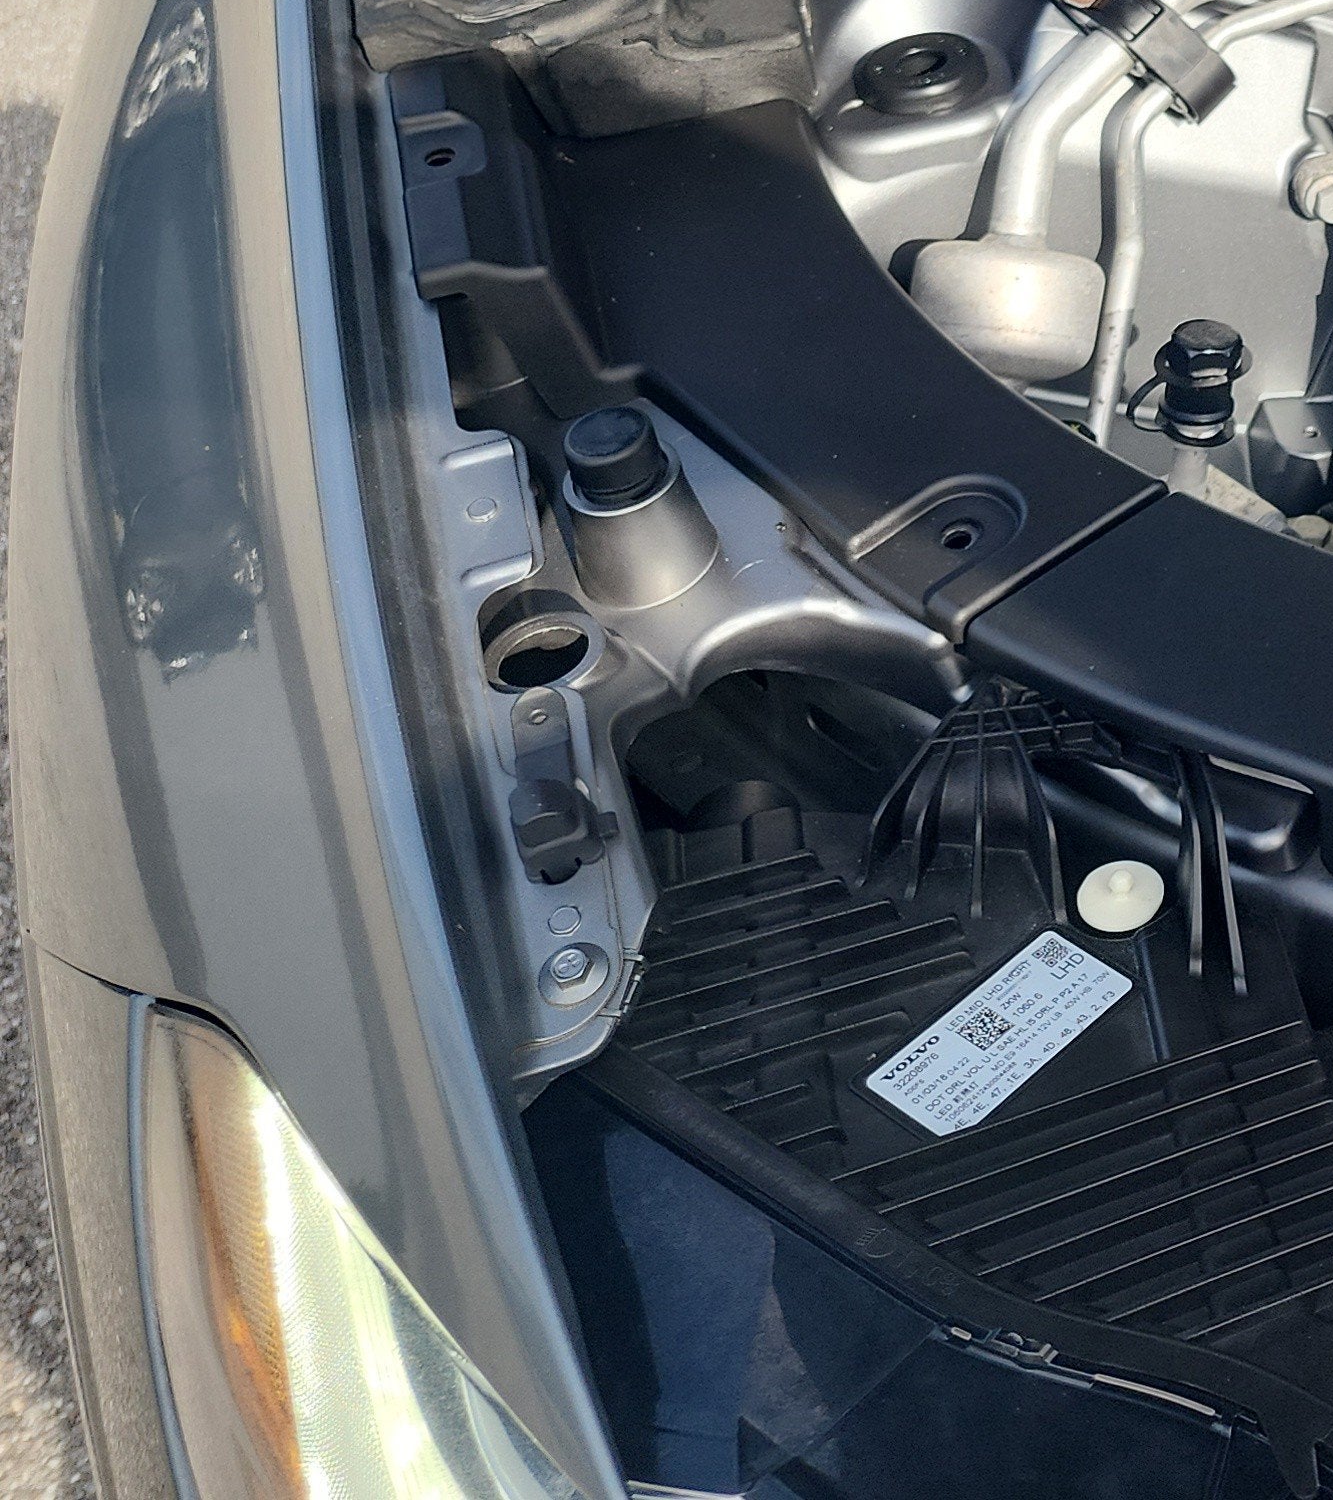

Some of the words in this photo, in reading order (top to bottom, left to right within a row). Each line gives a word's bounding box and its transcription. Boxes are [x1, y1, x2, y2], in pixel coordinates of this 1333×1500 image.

[1052, 953, 1085, 980] LHD
[945, 1015, 965, 1031] LED
[965, 1000, 984, 1015] MID
[982, 983, 1003, 1000] LHD
[1002, 960, 1032, 984] RIGHT
[1000, 992, 1022, 1009] ZKW
[1101, 990, 1115, 1001] F3
[924, 1094, 946, 1111] DOT
[963, 1062, 984, 1078] VOL
[1059, 987, 1072, 998] P2
[1077, 973, 1089, 982] 17
[882, 1035, 939, 1082] VOLVO
[933, 1103, 953, 1119] LED
